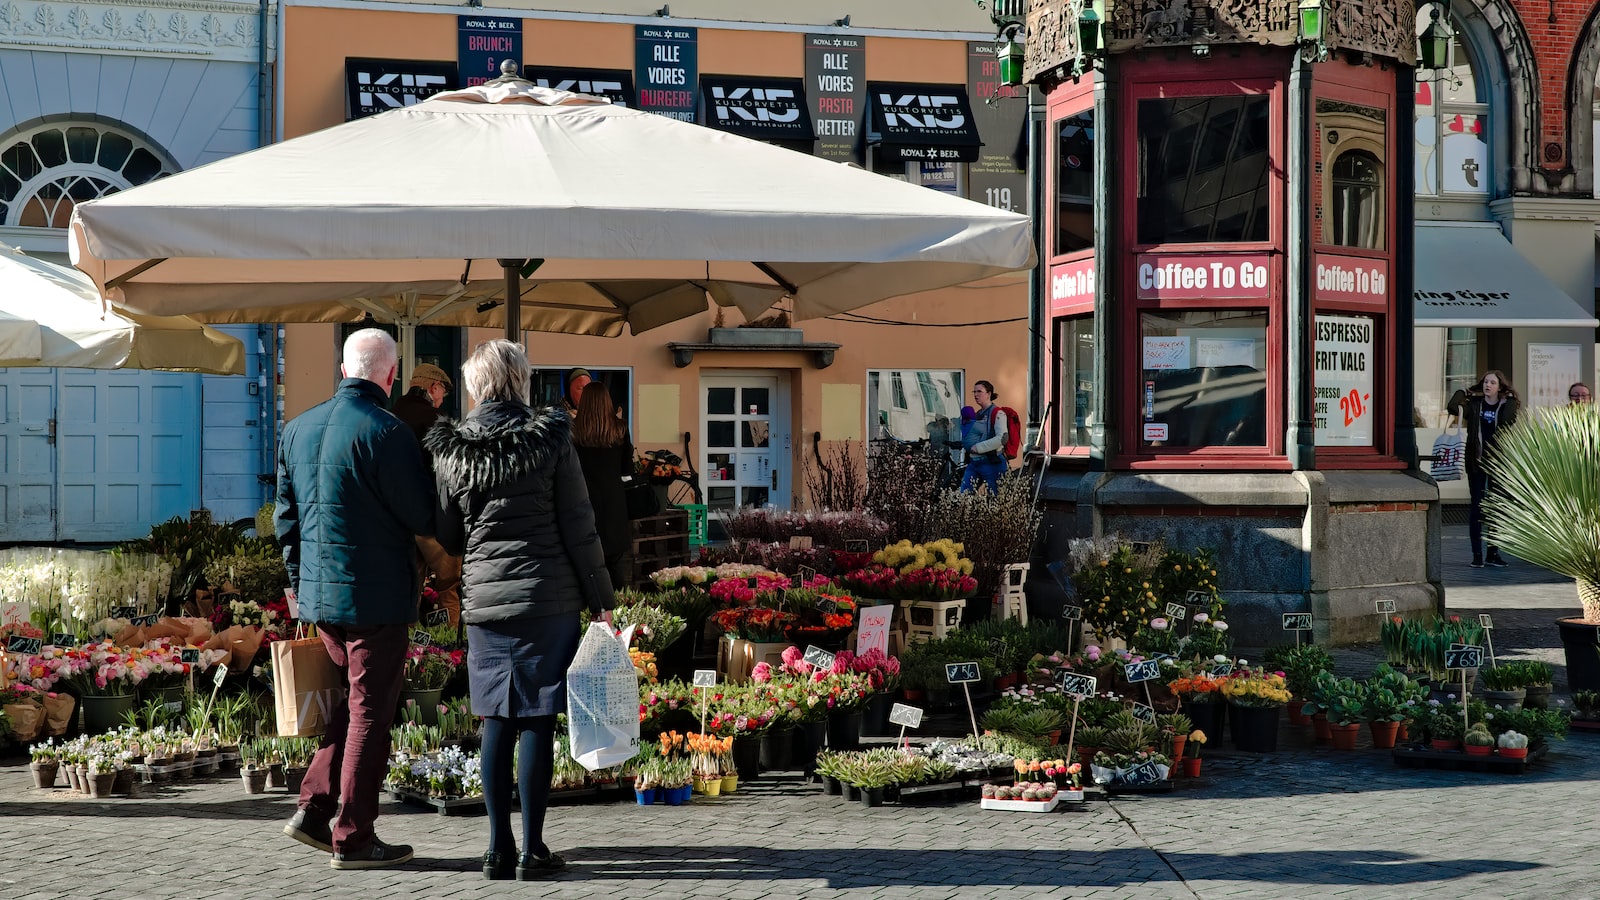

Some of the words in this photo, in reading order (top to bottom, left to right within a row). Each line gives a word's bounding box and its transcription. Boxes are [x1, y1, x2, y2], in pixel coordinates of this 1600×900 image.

[466, 20, 486, 28] ROYAL
[468, 35, 513, 53] BRUNCH
[975, 46, 994, 54] ROYAL
[653, 44, 681, 63] ALLE
[823, 53, 849, 71] ALLE
[648, 66, 686, 85] VORES
[817, 74, 854, 93] VORES
[640, 88, 693, 107] BURGERE
[714, 99, 797, 109] KULTORVET15
[818, 97, 854, 115] PASTA
[883, 106, 962, 115] KULTORVET15
[751, 121, 802, 129] Restaurant
[816, 118, 856, 137] RETTER
[900, 148, 925, 157] ROYAL
[940, 150, 960, 158] BEER
[1052, 273, 1077, 300] Coffee
[1076, 270, 1087, 295] To
[1139, 263, 1208, 291] Coffee
[1209, 262, 1236, 289] To
[1239, 261, 1268, 289] Go
[1316, 263, 1355, 293] Coffee
[1355, 267, 1370, 294] To
[1370, 268, 1386, 296] Go
[1455, 289, 1511, 302] tiger
[1315, 350, 1338, 371] FRIT
[1340, 351, 1366, 372] VALG
[1459, 651, 1477, 667] 68
[1142, 662, 1158, 680] 58
[1078, 677, 1094, 697] 38
